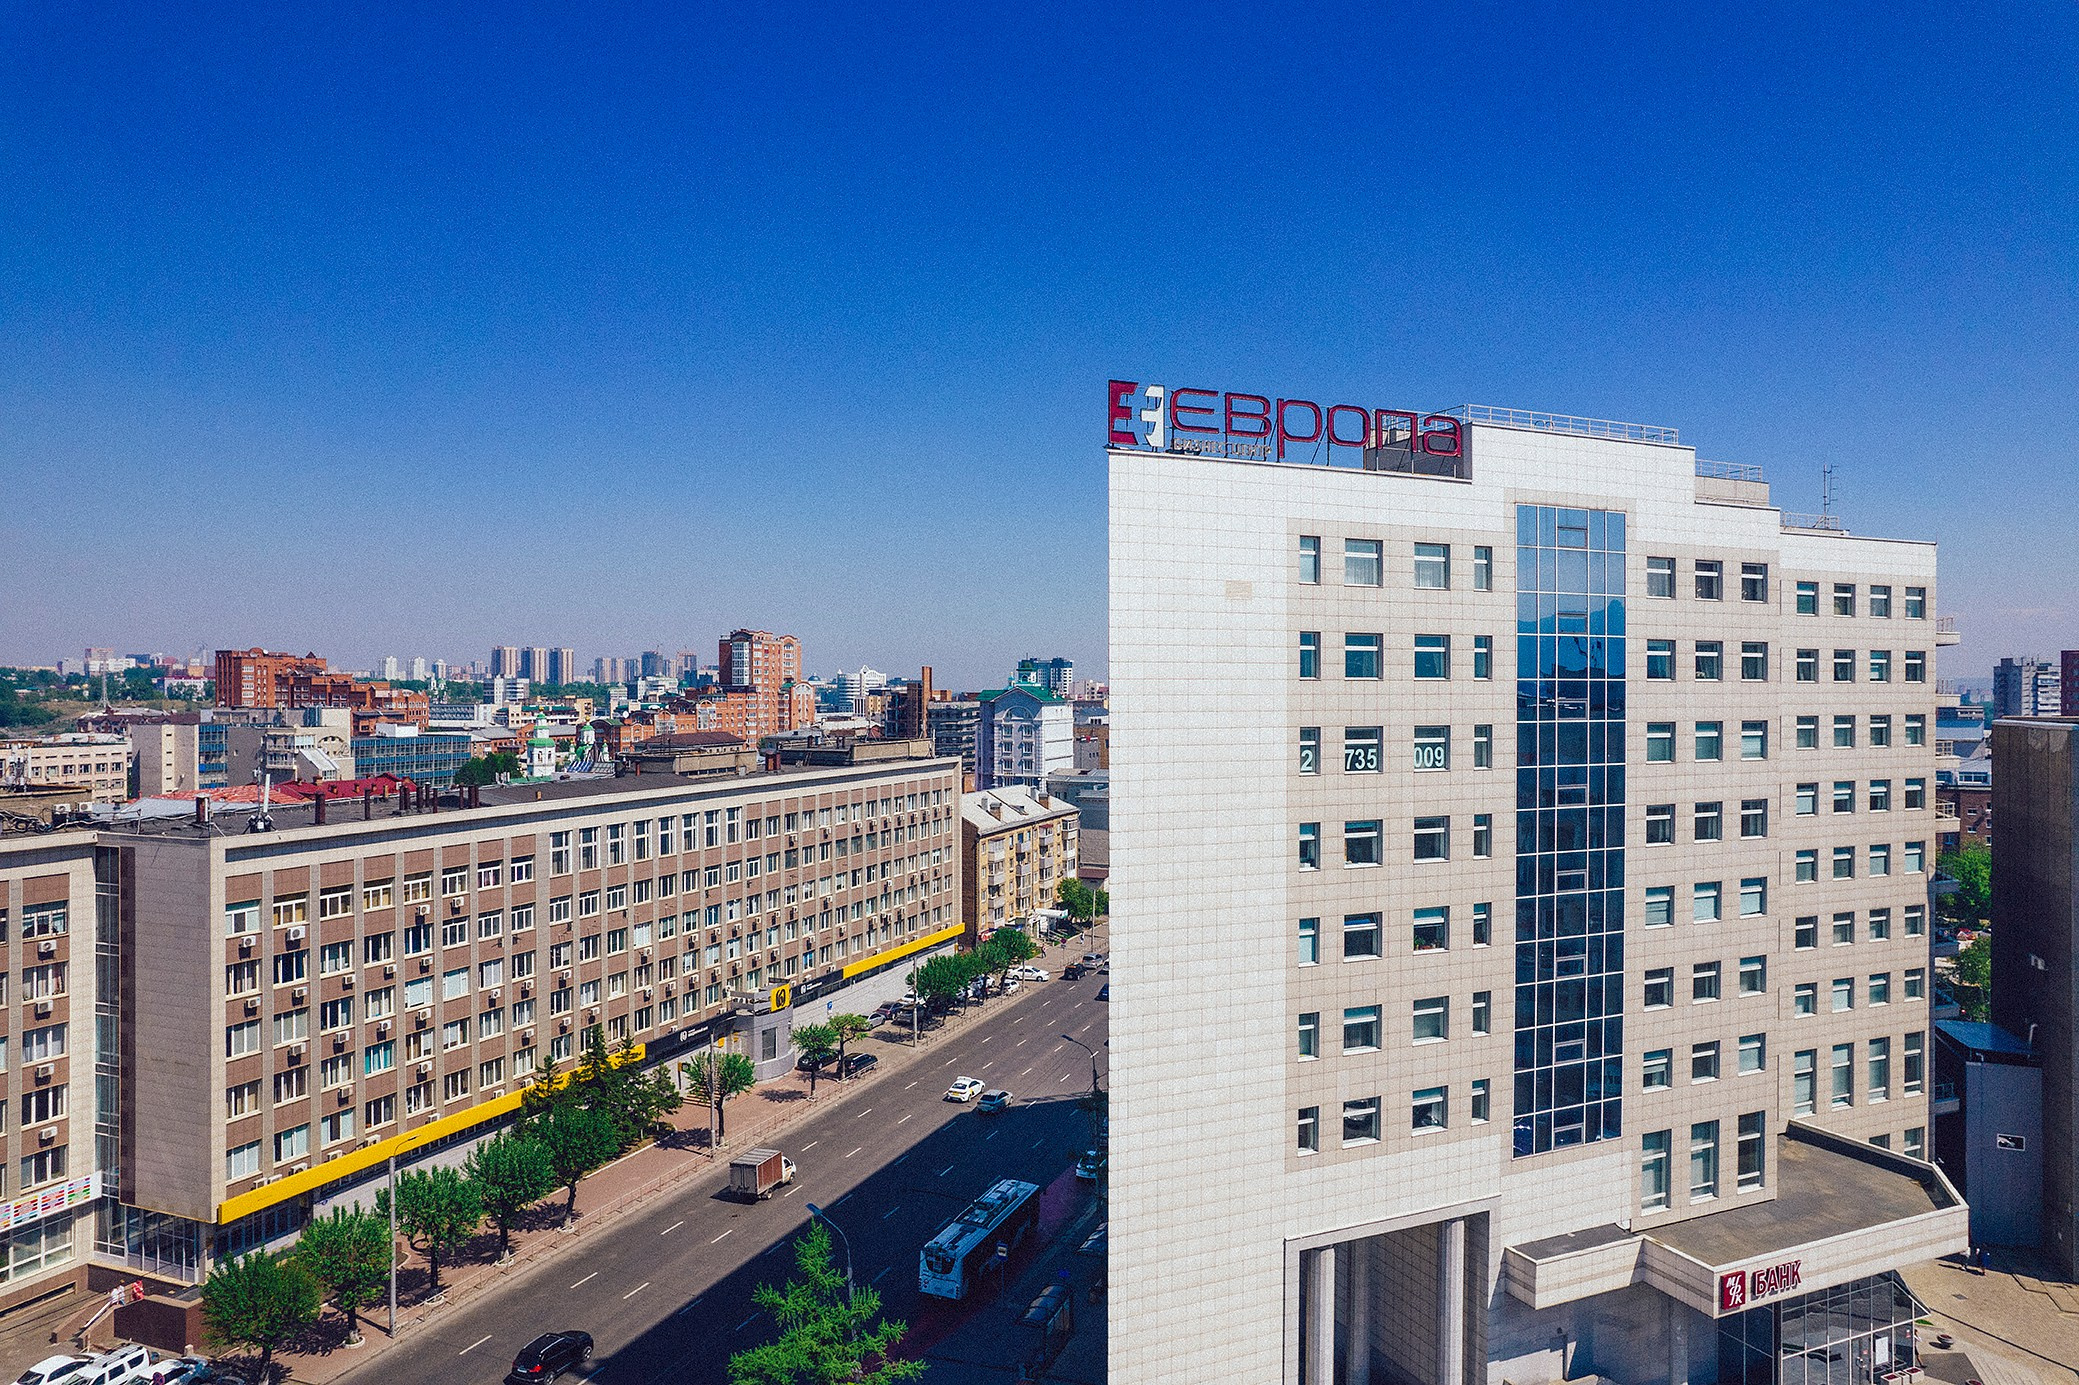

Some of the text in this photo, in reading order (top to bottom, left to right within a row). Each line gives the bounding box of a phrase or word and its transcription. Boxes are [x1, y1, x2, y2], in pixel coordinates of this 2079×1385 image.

[1301, 746, 1445, 771] 2 735 009
[1754, 1260, 1802, 1297] БАНК
